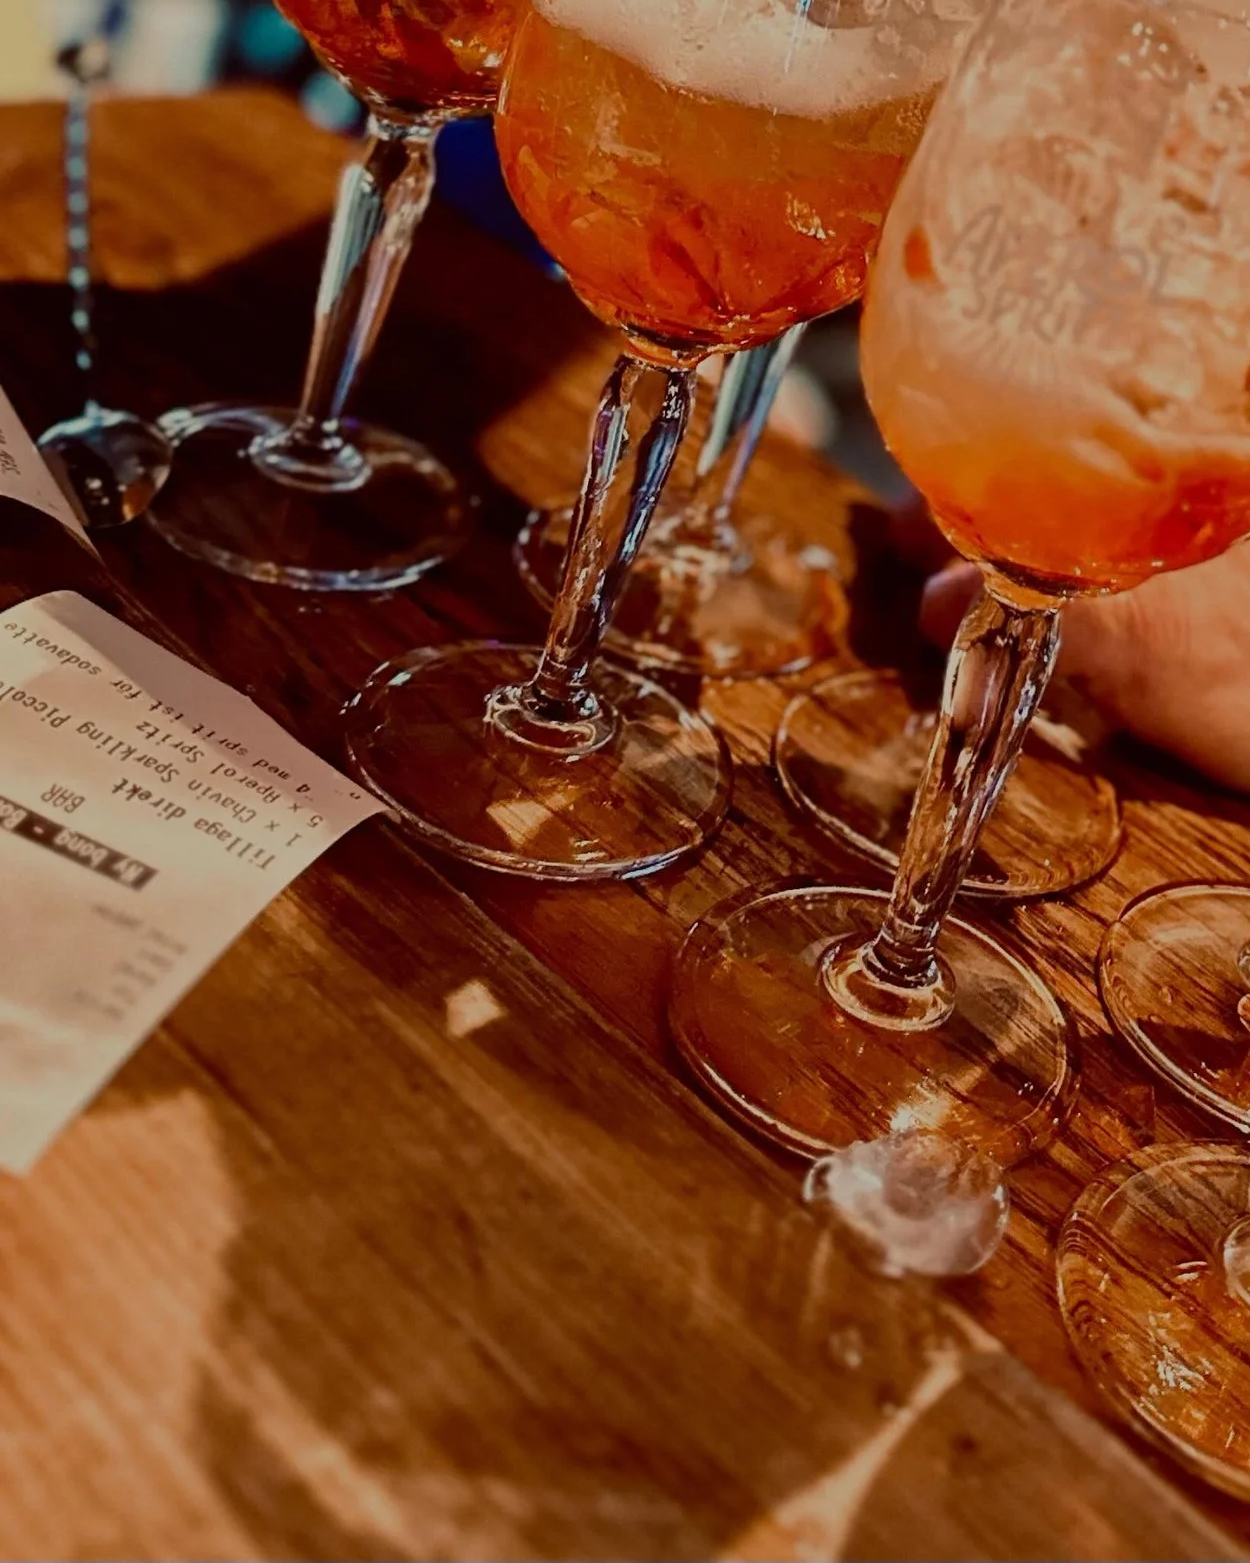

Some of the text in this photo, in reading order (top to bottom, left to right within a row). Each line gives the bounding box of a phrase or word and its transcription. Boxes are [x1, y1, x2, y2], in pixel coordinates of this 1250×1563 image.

[4, 622, 102, 676] sodavatte
[109, 679, 143, 700] för
[149, 700, 185, 723] ist
[75, 720, 180, 783] Sparkling
[191, 722, 249, 756] sprit
[135, 720, 324, 829] 5 x Aperol Spritz
[251, 758, 292, 781] med
[40, 783, 86, 814] BAR
[187, 778, 257, 824] Chavin
[0, 800, 28, 830] Bo
[111, 777, 276, 871] Tillaga direkt
[264, 819, 281, 832] x
[53, 827, 109, 868] bong
[285, 833, 302, 847] 1
[111, 858, 145, 883] Ny
